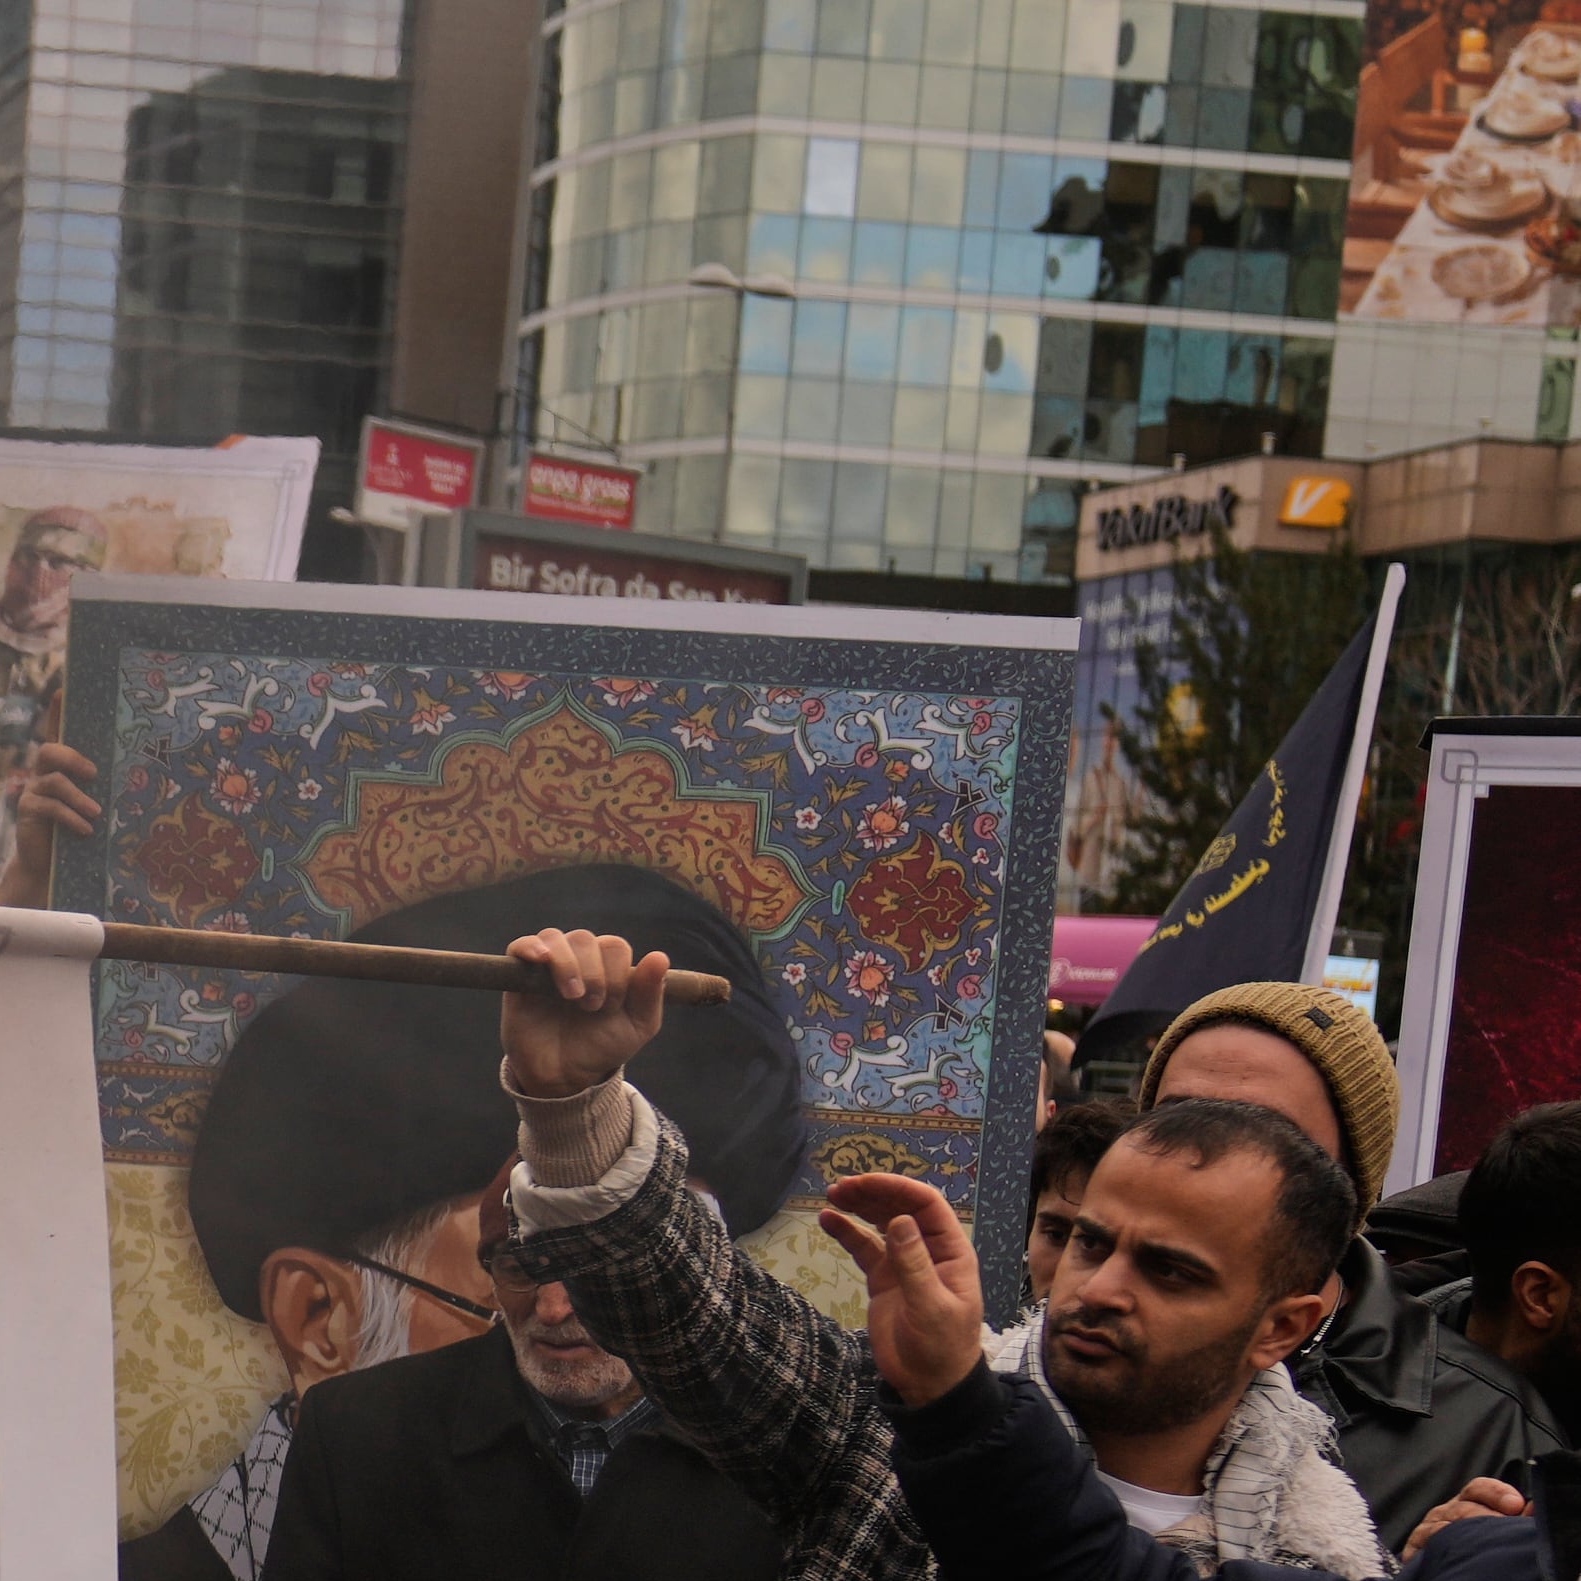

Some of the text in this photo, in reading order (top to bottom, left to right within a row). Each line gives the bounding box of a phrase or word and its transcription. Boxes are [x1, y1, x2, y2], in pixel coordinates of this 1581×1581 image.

[490, 553, 535, 590] Bir
[539, 560, 617, 597] Sofra
[624, 572, 660, 601] da
